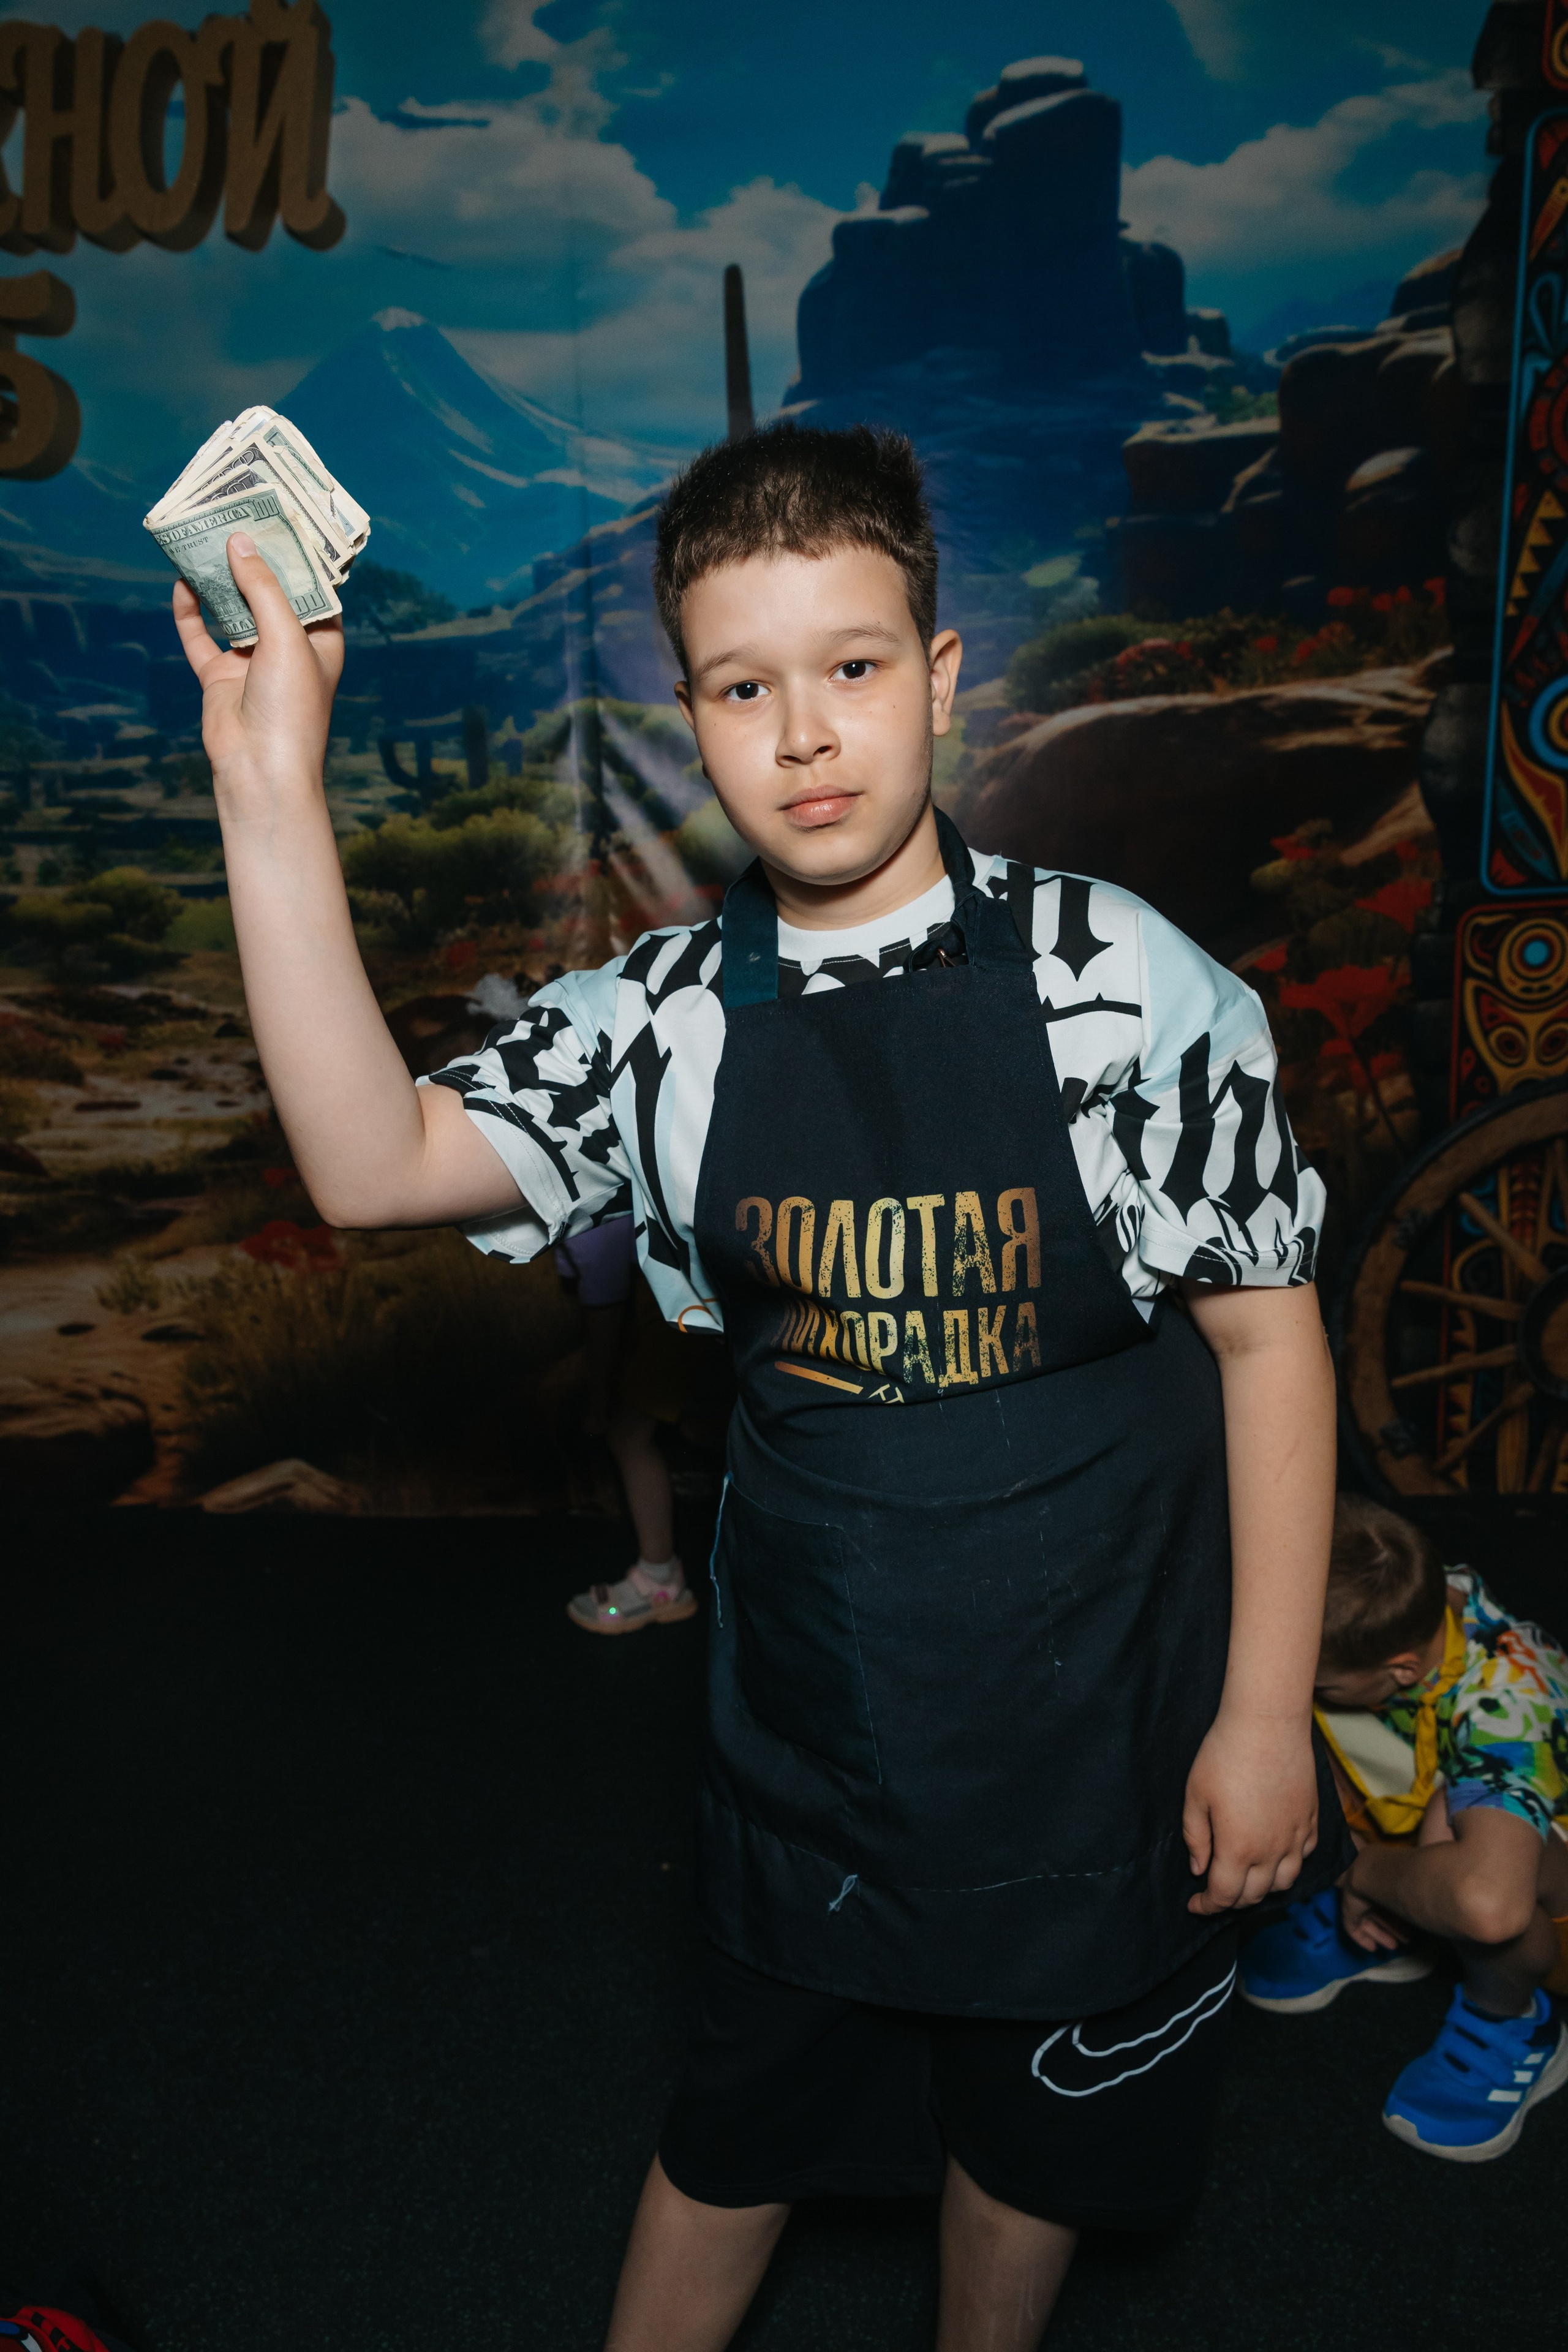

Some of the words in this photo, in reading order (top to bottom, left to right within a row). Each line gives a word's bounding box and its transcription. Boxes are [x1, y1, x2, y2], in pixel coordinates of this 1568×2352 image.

[187, 506, 251, 535] AMERICA
[251, 495, 281, 522] 100
[182, 536, 209, 551] TRUST
[288, 590, 326, 617] 00
[735, 1186, 1041, 1299] ЗОЛОТАЯ
